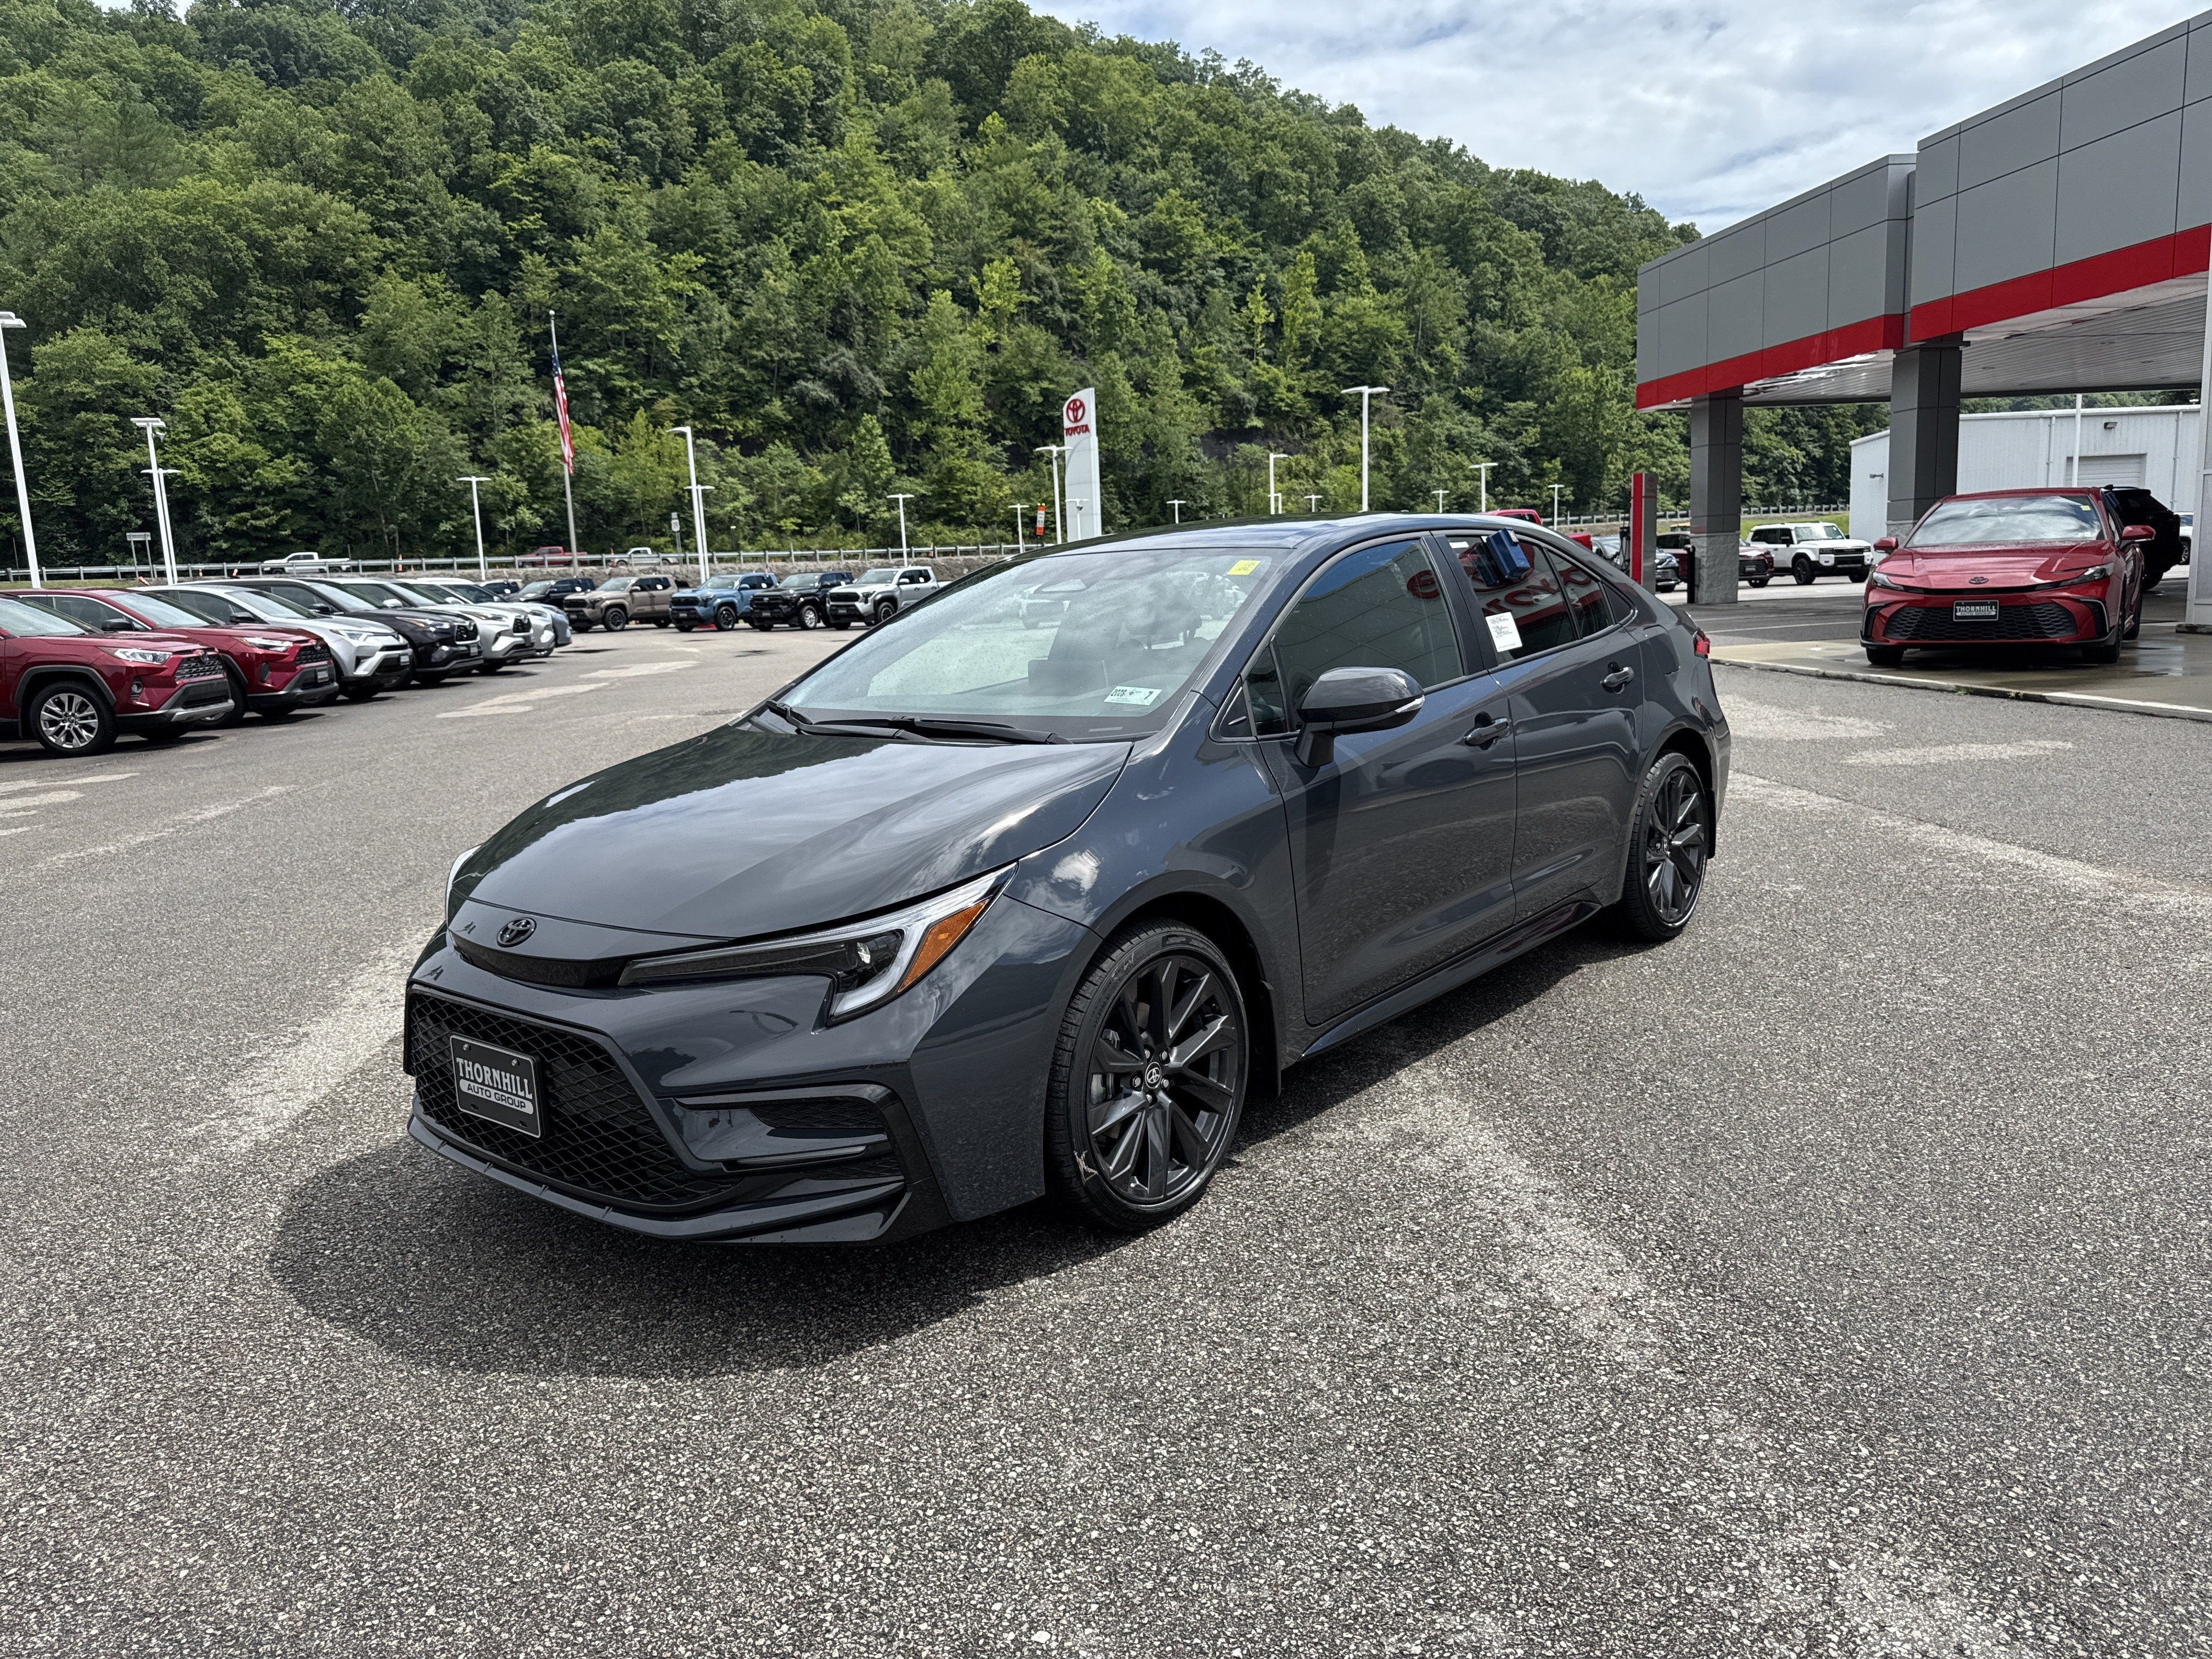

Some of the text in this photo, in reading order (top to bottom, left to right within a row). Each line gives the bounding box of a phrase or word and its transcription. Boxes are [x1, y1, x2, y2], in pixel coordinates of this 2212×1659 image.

[1064, 424, 1090, 436] TOYOTA
[456, 1057, 533, 1099] THORNHILL
[467, 1083, 526, 1109] AUTO GROUP
